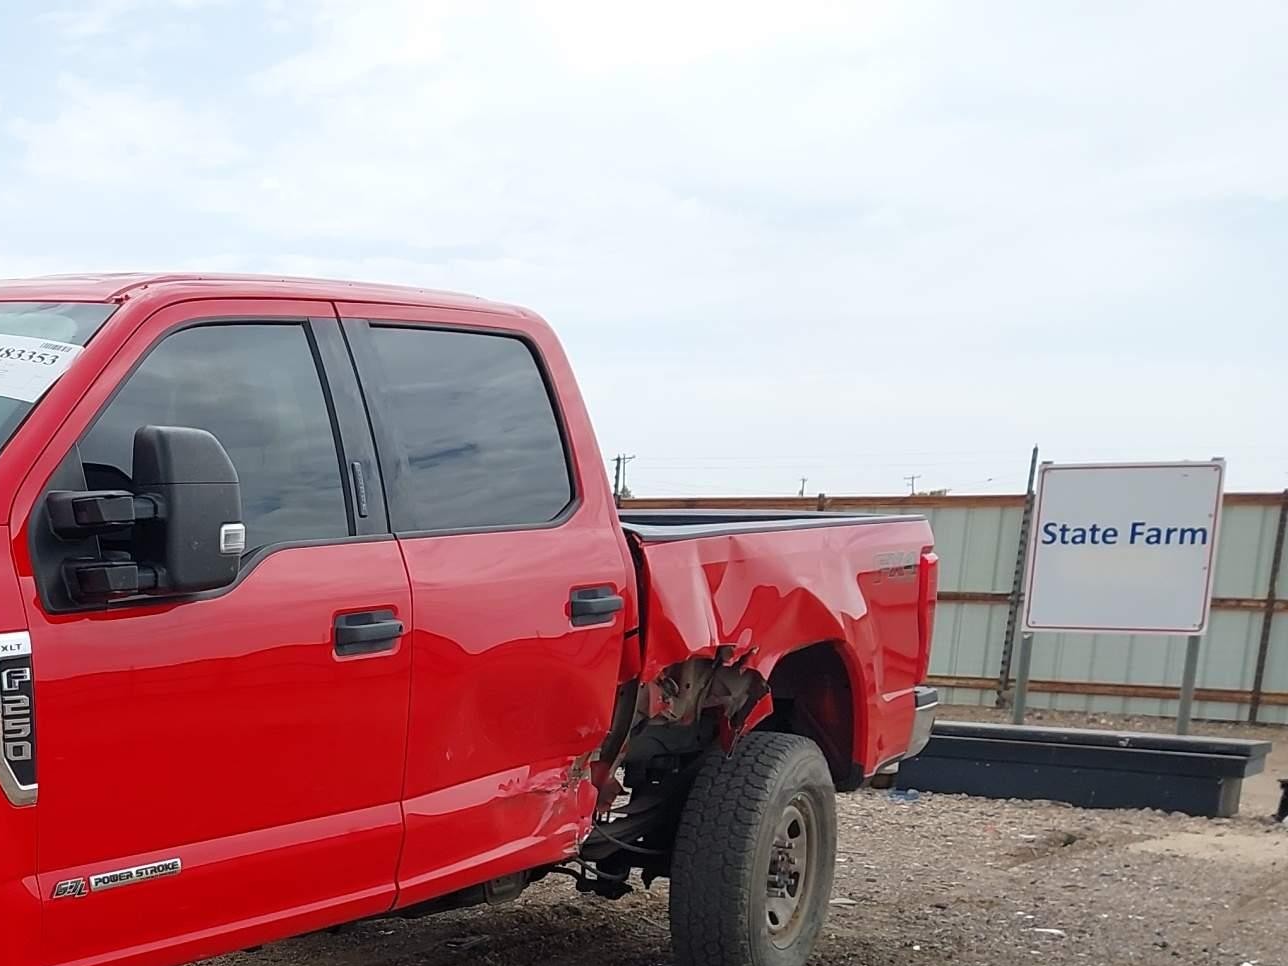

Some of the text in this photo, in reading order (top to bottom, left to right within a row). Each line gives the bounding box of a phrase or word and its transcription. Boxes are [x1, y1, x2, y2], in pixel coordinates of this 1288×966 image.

[1041, 521, 1208, 545] State Farm
[0, 643, 23, 652] XLT
[1, 667, 32, 761] F250
[94, 871, 133, 886] POWER
[136, 860, 180, 877] STROKE
